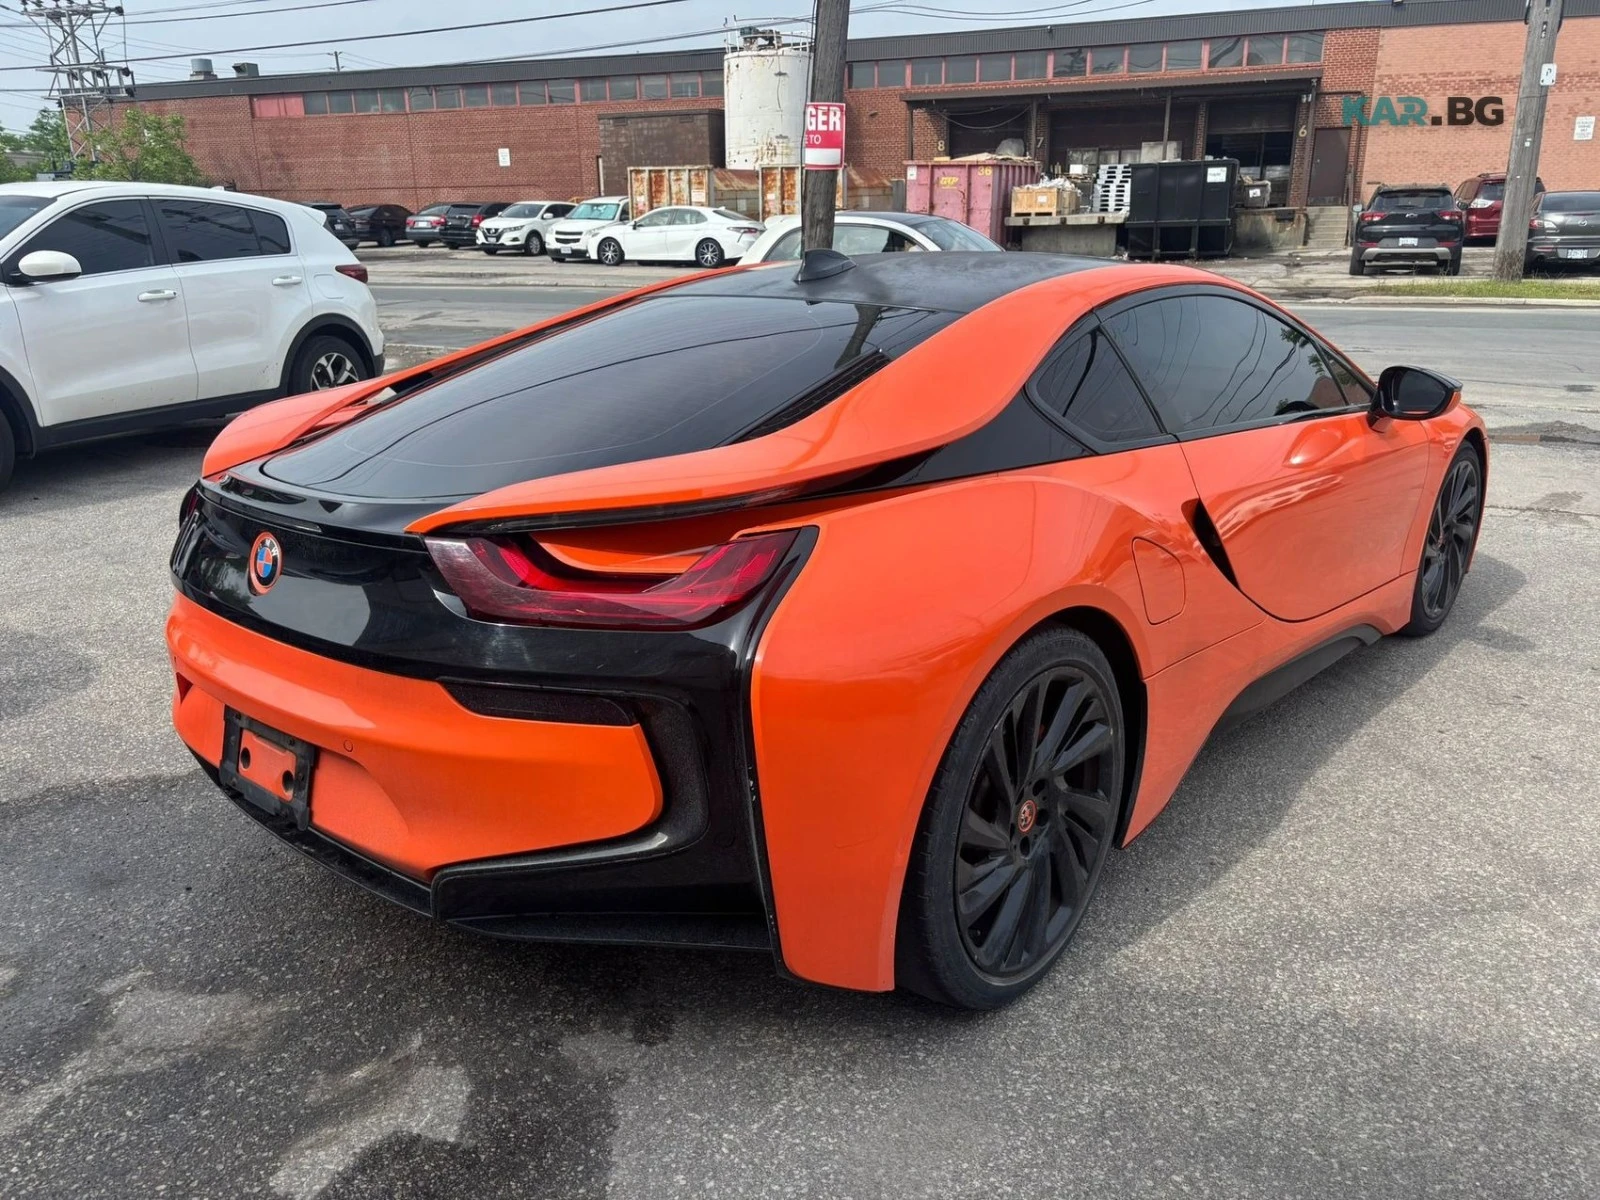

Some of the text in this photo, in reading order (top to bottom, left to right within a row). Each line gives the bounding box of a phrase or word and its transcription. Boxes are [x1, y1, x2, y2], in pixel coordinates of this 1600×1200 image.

[807, 105, 841, 131] GER
[1298, 125, 1307, 137] 6
[809, 134, 822, 145] TO
[1037, 137, 1044, 148] 7
[937, 140, 945, 151] 8
[978, 166, 993, 176] 36
